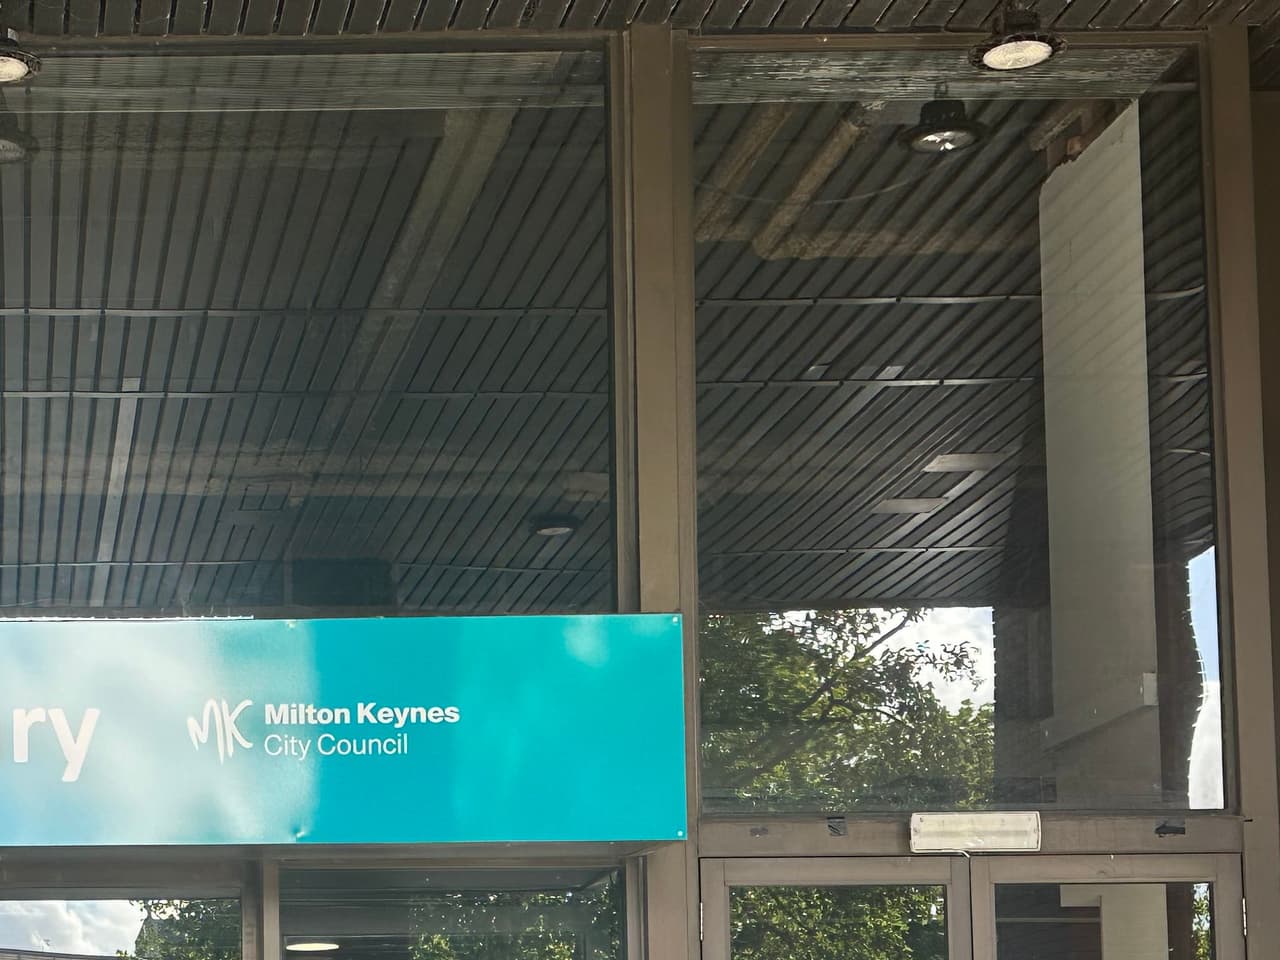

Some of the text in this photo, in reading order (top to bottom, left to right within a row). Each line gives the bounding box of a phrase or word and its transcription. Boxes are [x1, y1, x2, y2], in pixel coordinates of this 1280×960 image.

[264, 702, 460, 728] Milton Keynes
[264, 733, 408, 760] City Council
